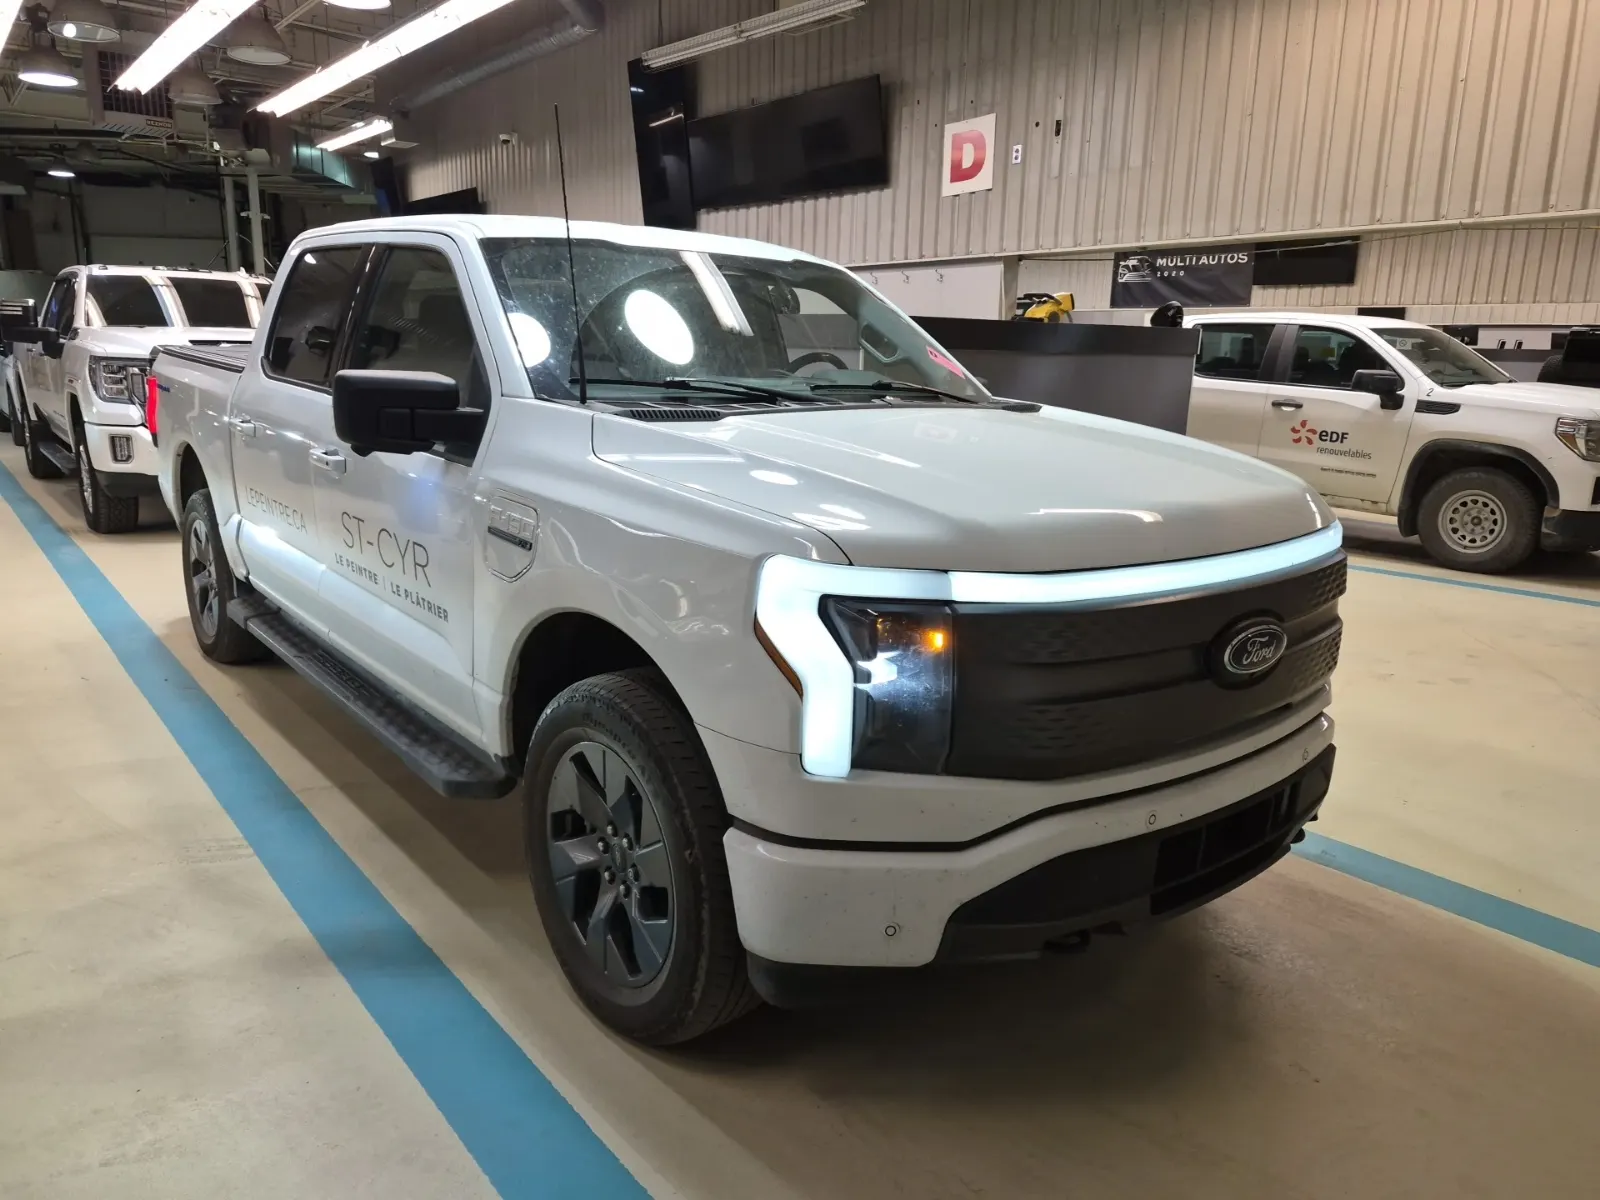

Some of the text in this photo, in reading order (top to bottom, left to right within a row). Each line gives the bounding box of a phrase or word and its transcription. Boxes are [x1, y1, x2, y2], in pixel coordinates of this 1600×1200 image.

[949, 129, 987, 184] D
[1156, 252, 1249, 267] MULTI AUTOS
[1425, 387, 1435, 397] 2
[1316, 446, 1372, 460] renouvelables
[341, 511, 432, 588] ST-CYR
[334, 552, 449, 622] LE PEINTRE LE PLÂTRIER
[1242, 636, 1276, 663] Ford
